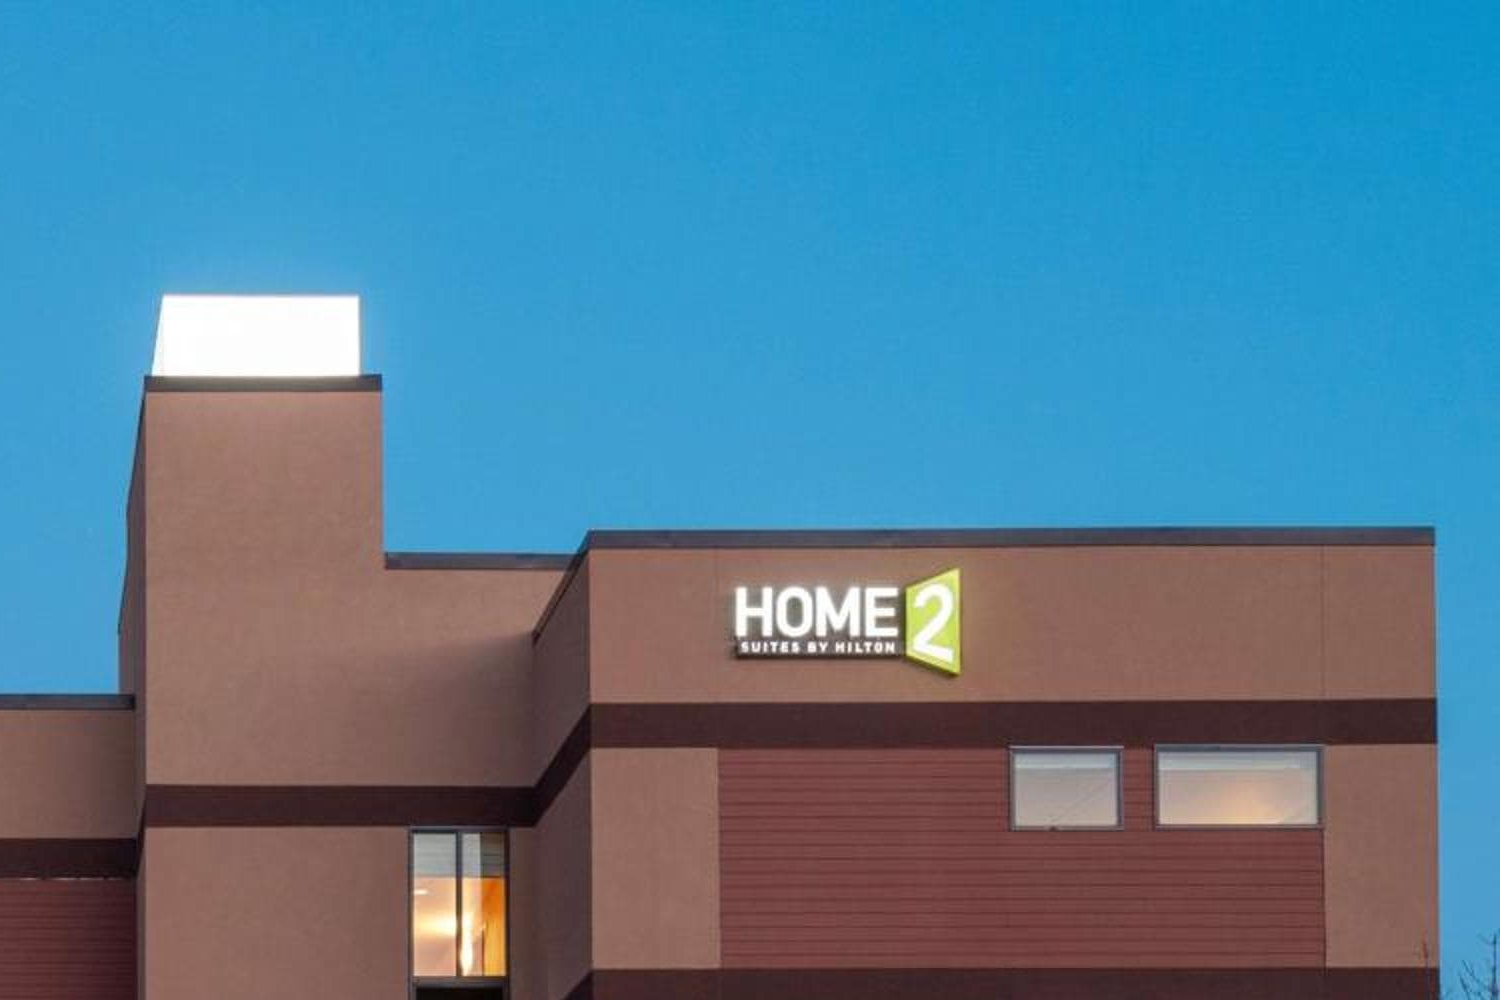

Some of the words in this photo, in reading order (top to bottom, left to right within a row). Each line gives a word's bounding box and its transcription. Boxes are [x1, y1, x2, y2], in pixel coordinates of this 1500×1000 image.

[735, 586, 900, 638] HOME
[912, 583, 955, 665] 2
[740, 640, 801, 654] SUITES
[807, 640, 829, 654] BY
[835, 640, 896, 654] HILTON
